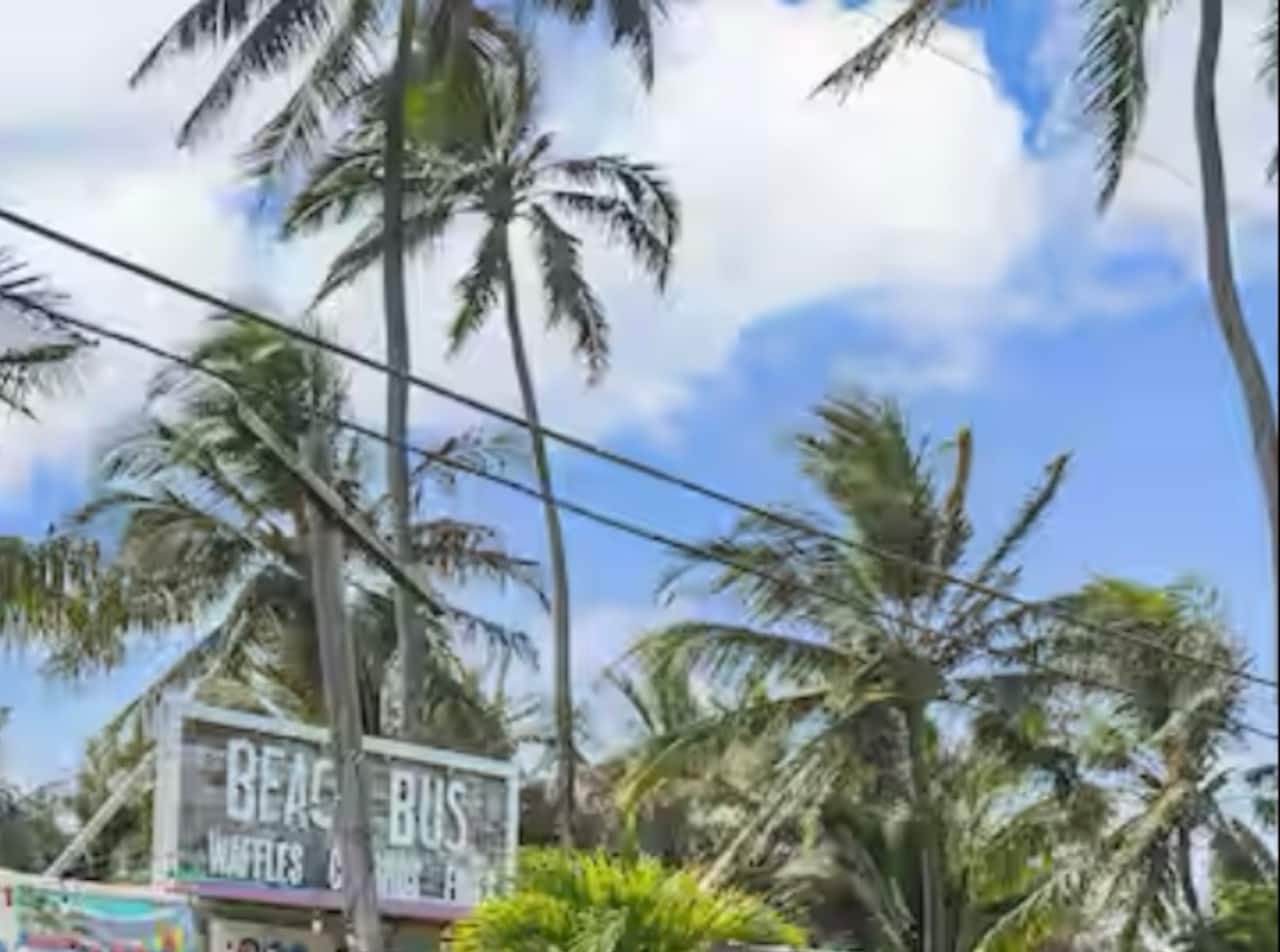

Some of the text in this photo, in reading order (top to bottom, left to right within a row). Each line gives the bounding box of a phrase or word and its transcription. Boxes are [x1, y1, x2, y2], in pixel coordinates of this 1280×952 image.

[225, 736, 467, 853] BEAC BUS
[208, 829, 304, 888] WAFFLES
